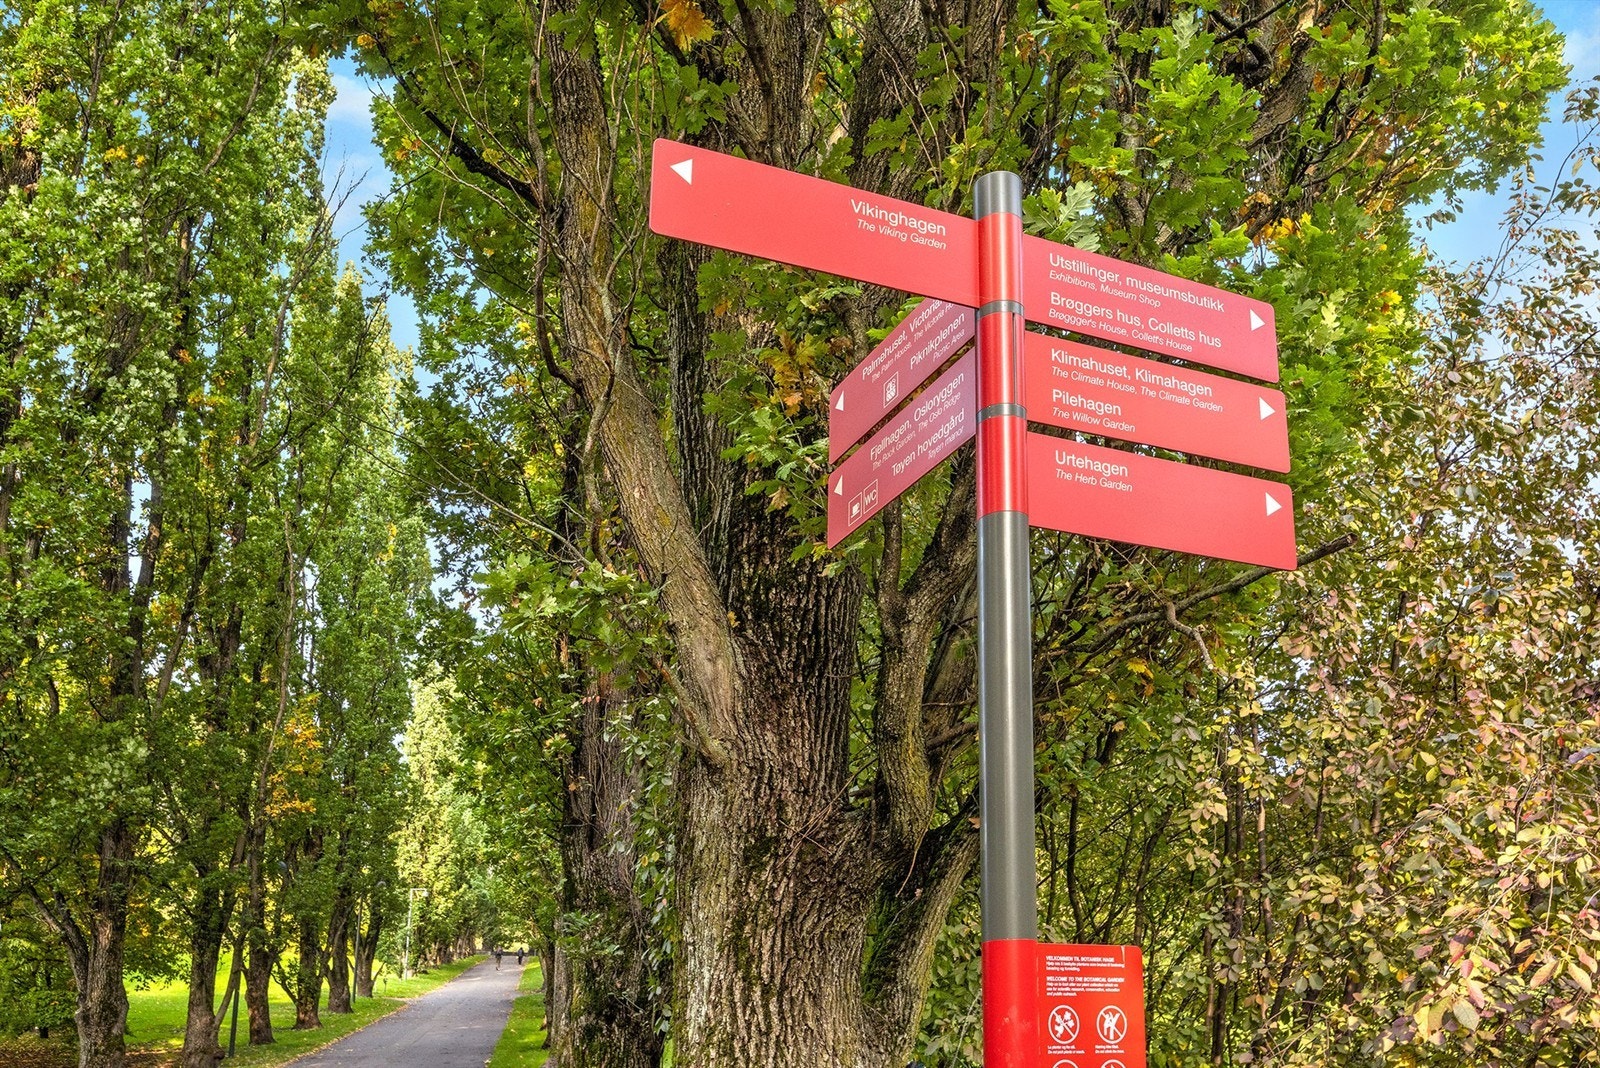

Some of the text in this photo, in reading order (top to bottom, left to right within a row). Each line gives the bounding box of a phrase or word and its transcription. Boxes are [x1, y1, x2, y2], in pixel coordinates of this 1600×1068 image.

[850, 199, 946, 236] Vikinghagen
[858, 218, 946, 250] The Viking Garden
[1050, 253, 1224, 312] Utstillinger, museumsbutikk
[1050, 270, 1161, 308] Exhibitions, Museum Shop
[1050, 292, 1222, 348] Brøggers hus, Colletts hus
[1099, 322, 1129, 337] House,
[1166, 338, 1192, 352] House
[862, 330, 908, 380] Palmehuset,
[910, 313, 964, 370] Piknikplenen
[1051, 348, 1212, 396] Klimahuset, Klimahagen
[1052, 366, 1223, 412] The Climate House, The Climate Garden
[870, 372, 964, 461] Fjellhagen, Osloryggen
[1052, 389, 1122, 416] Pilehagen
[1052, 407, 1136, 432] The Willow Garden
[892, 408, 965, 477] Tøyen hovedgård
[1056, 450, 1128, 477] Urtehagen
[1056, 468, 1132, 492] The Herb Garden
[865, 489, 877, 505] WC
